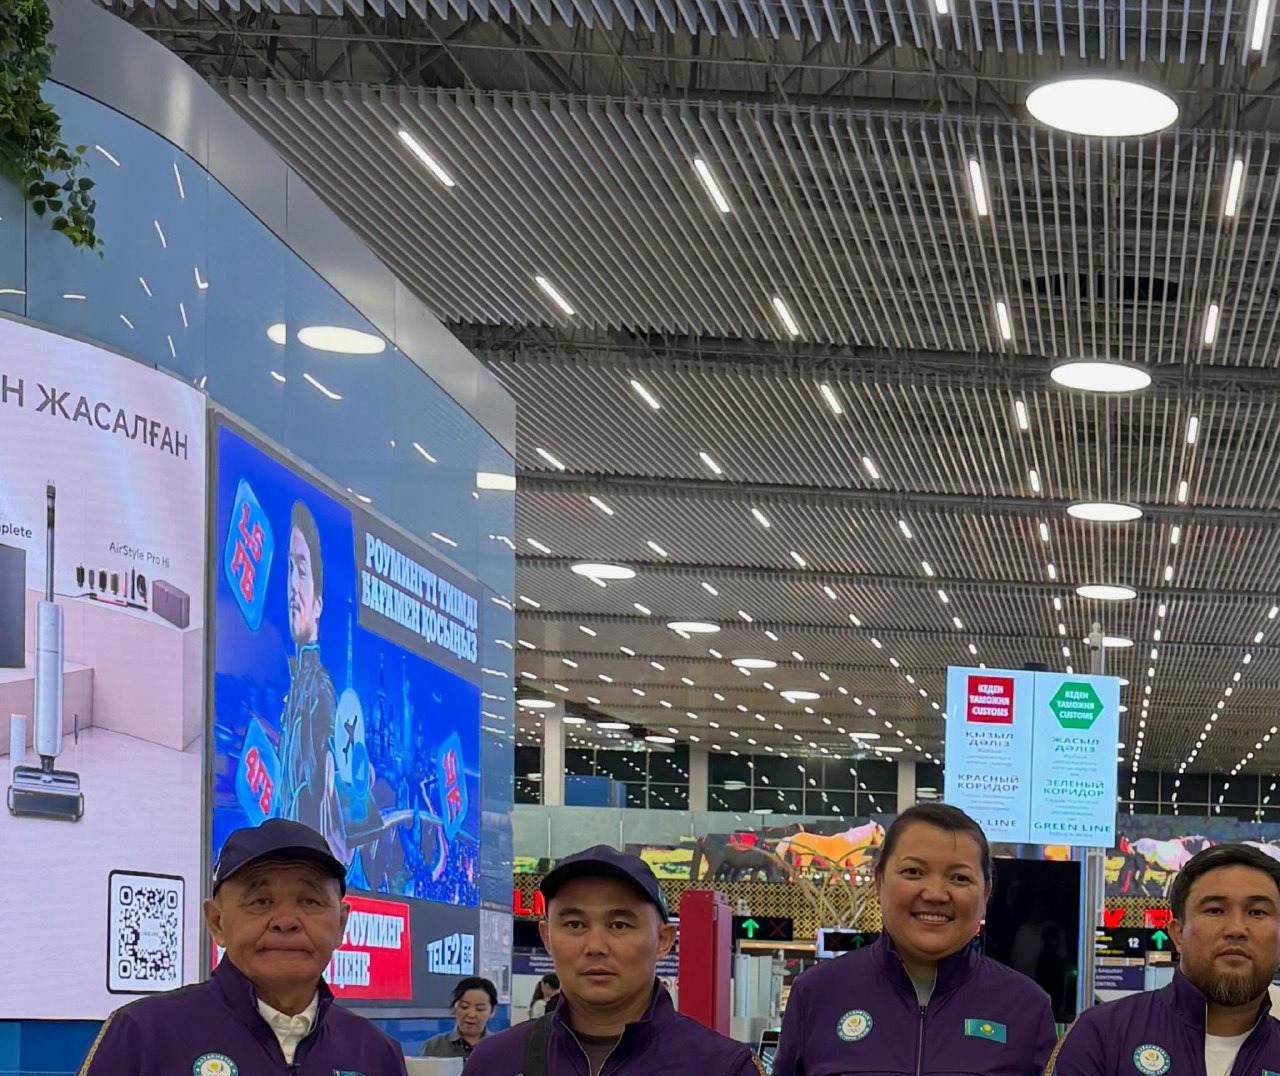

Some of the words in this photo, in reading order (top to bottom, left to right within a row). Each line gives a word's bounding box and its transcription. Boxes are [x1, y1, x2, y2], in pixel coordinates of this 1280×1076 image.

[35, 382, 188, 460] ЖАСАЛҒАН
[0, 523, 33, 539] plete
[109, 541, 145, 561] AirStyle
[146, 551, 161, 565] Pro
[365, 531, 438, 606] РОУМИНГТІ
[958, 774, 1019, 783] КРАСНЫЙ
[957, 782, 1019, 792] КОРИДОР
[1043, 787, 1104, 798] КОРИДОР
[987, 819, 1018, 828] LINE
[1034, 822, 1078, 831] GREEN
[1082, 824, 1112, 832] LINE
[1128, 937, 1140, 949] 12
[427, 933, 461, 975] TELE2
